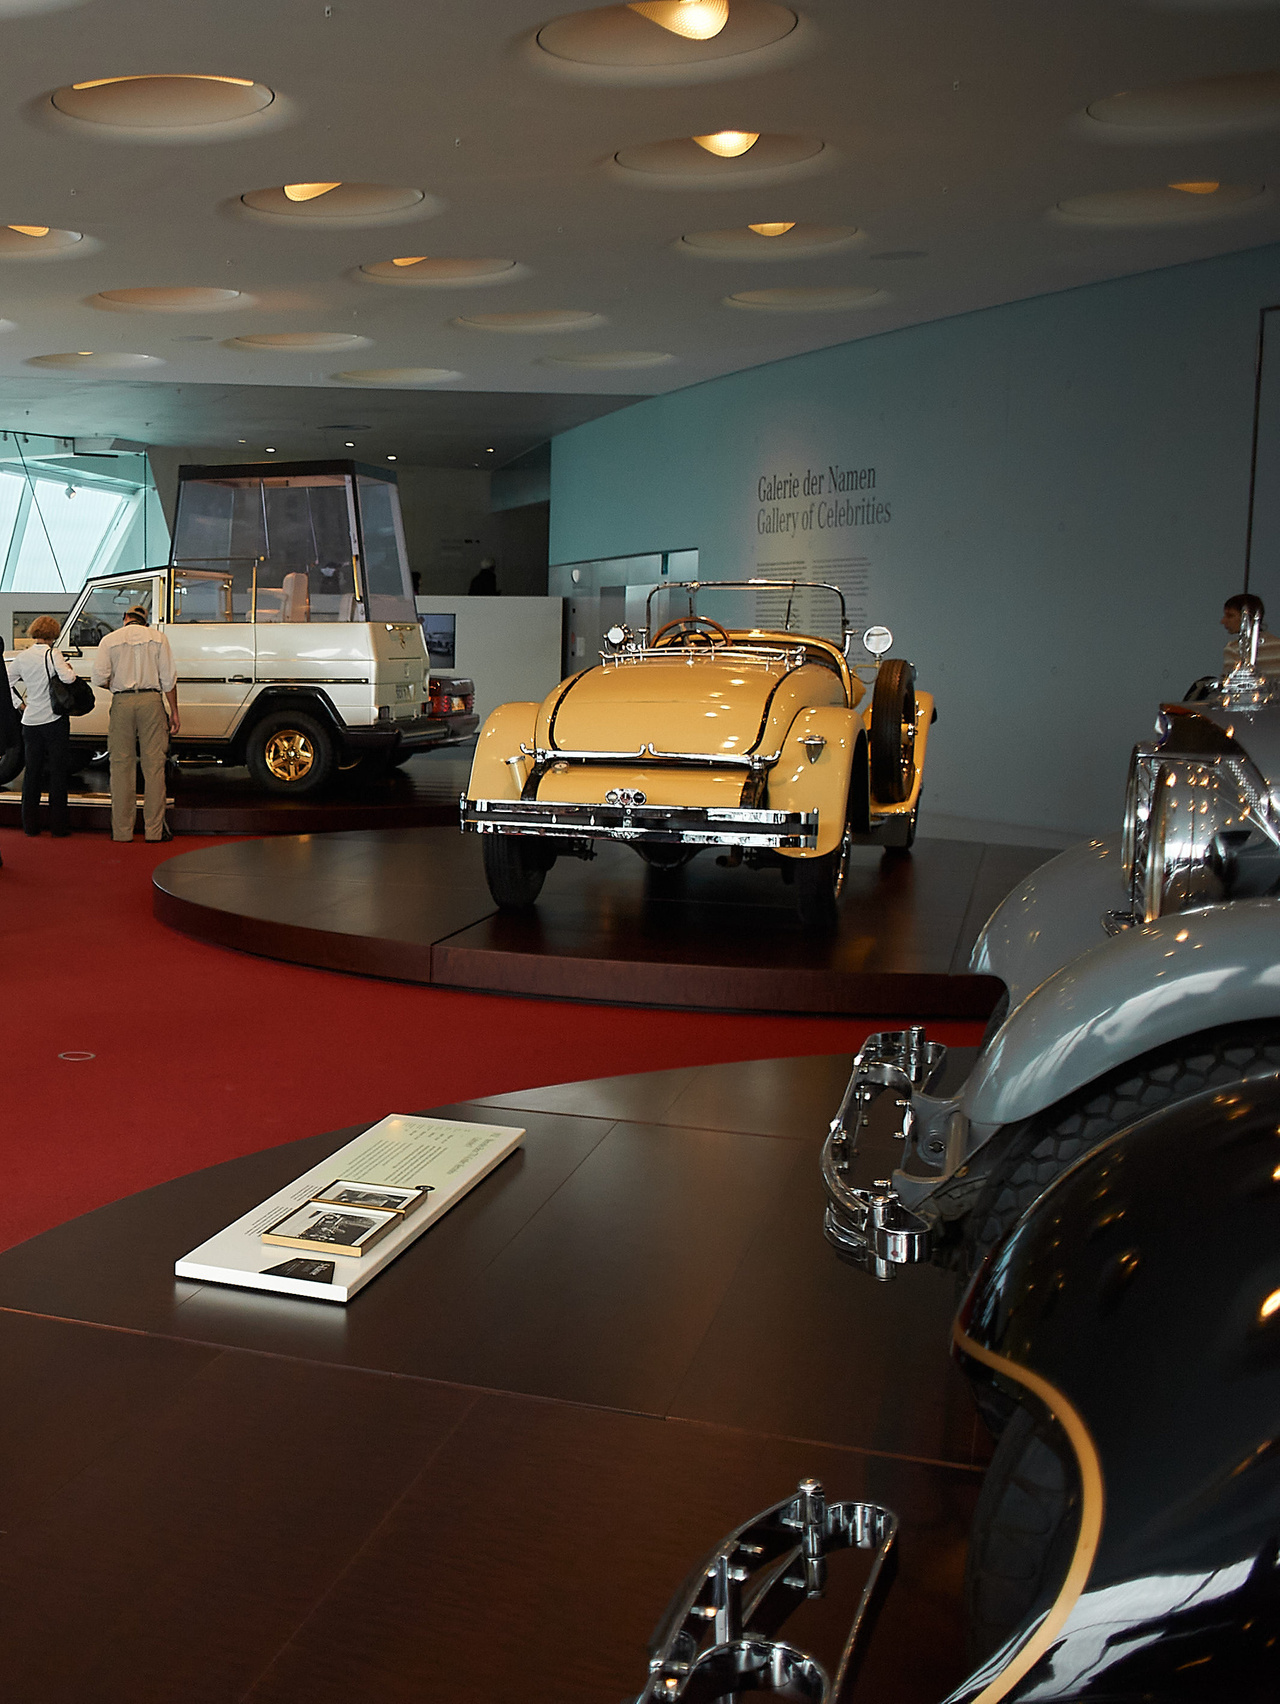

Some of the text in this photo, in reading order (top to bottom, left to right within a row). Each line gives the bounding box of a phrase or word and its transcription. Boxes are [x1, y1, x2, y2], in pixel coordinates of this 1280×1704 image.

[758, 465, 876, 502] Galerie der Namen
[757, 497, 891, 539] Gallery of Celebrities
